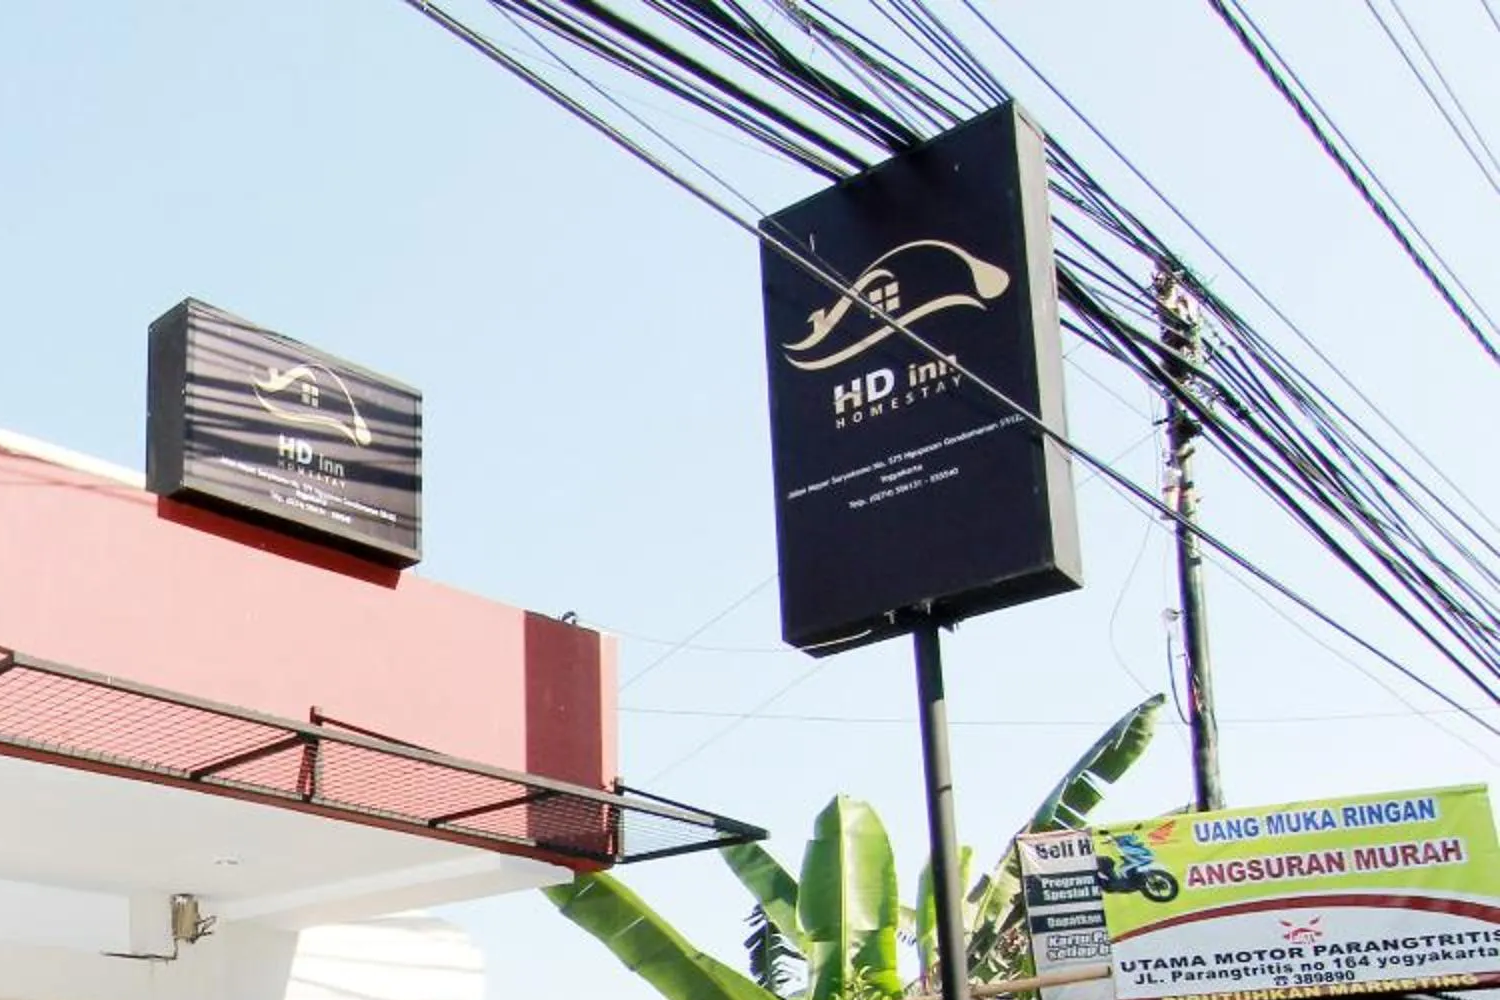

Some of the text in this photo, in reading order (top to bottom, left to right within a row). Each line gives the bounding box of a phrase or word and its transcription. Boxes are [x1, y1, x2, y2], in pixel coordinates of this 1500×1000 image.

[832, 367, 896, 415] HD
[835, 373, 962, 429] HOMESTAY
[278, 434, 313, 465] HD
[1194, 798, 1437, 843] UANG MUKA RINGAN
[1186, 838, 1463, 888] ANGSURAN MURAH
[1120, 954, 1207, 974] UTAMA
[1214, 946, 1305, 966] MOTOR
[1314, 929, 1500, 957] PARANGTRITIS
[1134, 945, 1499, 986] JL. Parangtritis no 164 yogyakarta
[1293, 969, 1356, 986] 389890
[1329, 973, 1480, 996] MARKETING
